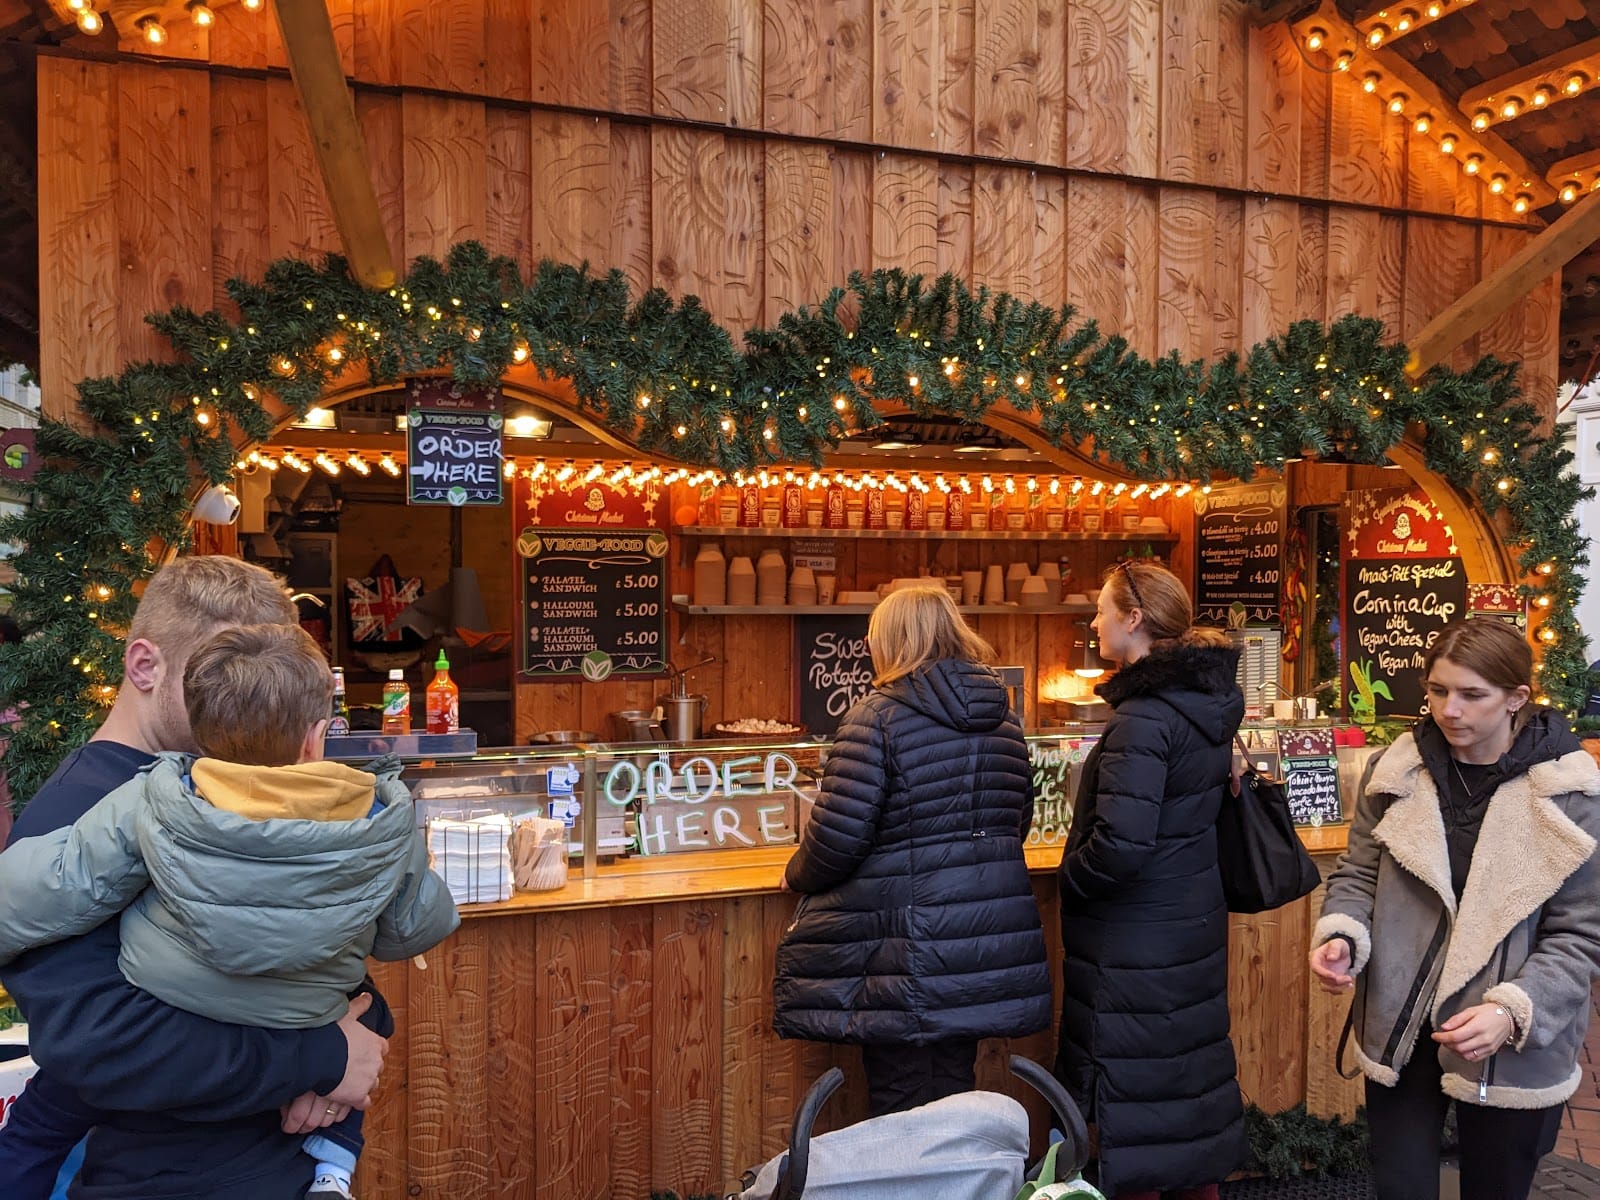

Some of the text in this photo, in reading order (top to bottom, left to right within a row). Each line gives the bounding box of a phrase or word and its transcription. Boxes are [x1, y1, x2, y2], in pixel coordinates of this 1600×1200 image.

[418, 436, 505, 461] ORDER
[433, 461, 496, 484] HERE
[542, 576, 586, 584] FALAFEL
[543, 584, 598, 593] SANDWICH
[543, 601, 594, 610] HALLOUMI
[543, 610, 598, 618] SANDWICH
[1353, 590, 1455, 623] Corn in a Cup
[1386, 614, 1414, 633] with
[543, 635, 594, 643] HALLOUMI
[543, 643, 598, 652] SANDWICH
[810, 632, 871, 659] Swe
[1358, 627, 1388, 654] Vegan
[808, 660, 872, 690] Potato
[1378, 650, 1409, 676] Vegan
[604, 752, 816, 806] ORDER
[635, 805, 797, 856] HERE
